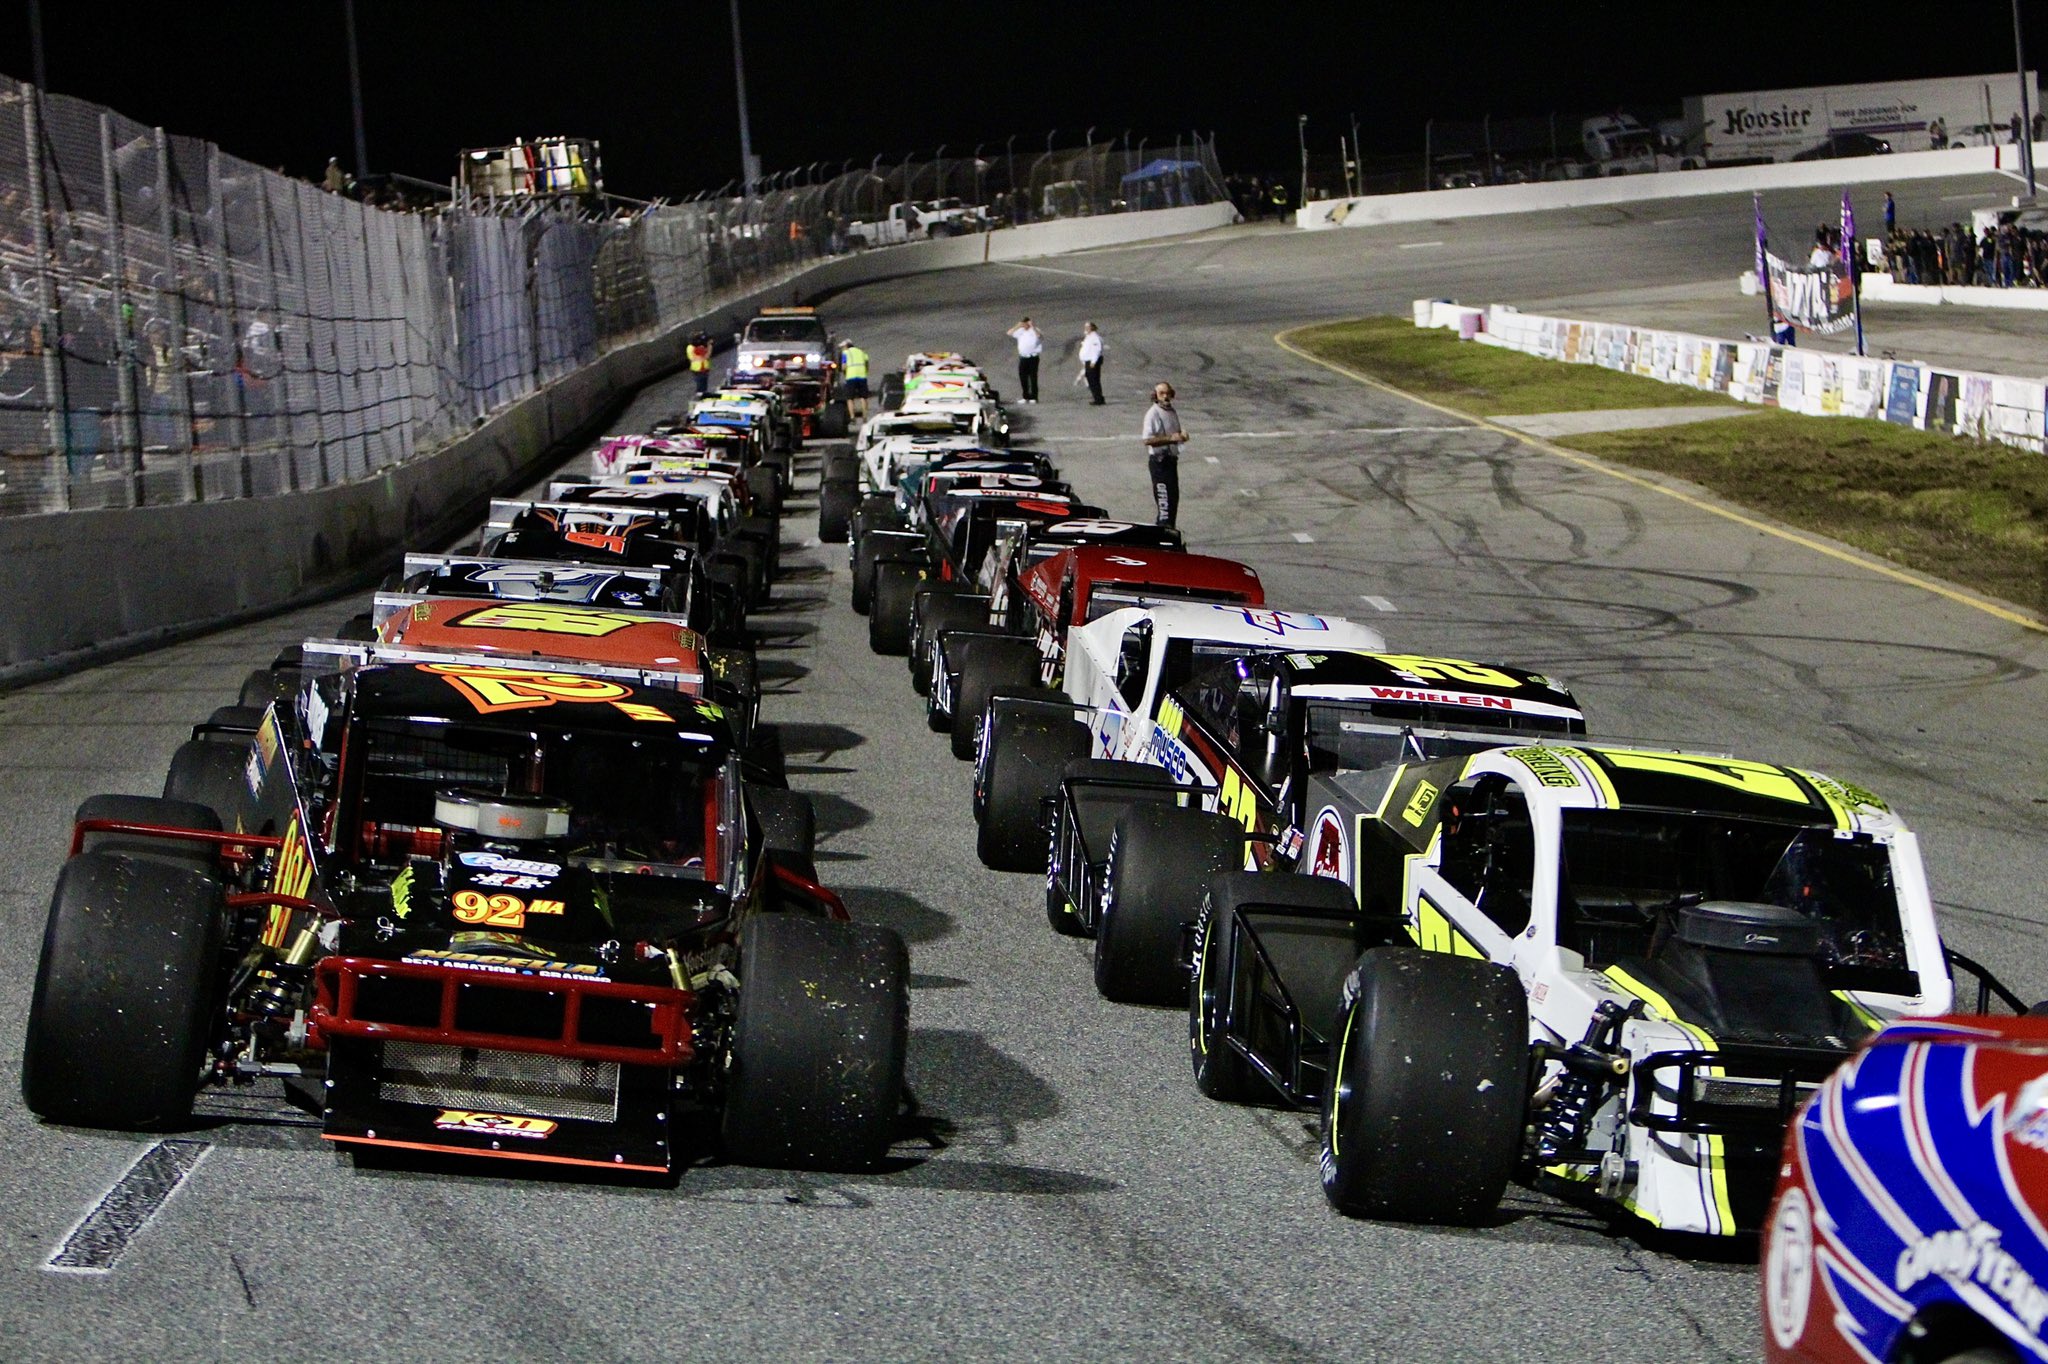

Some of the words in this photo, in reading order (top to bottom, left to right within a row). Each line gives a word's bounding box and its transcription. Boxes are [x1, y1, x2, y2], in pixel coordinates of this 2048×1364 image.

[1723, 104, 1811, 135] Hoosier
[981, 489, 1040, 499] WHELEN
[1369, 686, 1513, 709] WHELEN
[1150, 726, 1187, 782] MUSCO
[452, 890, 526, 928] 92
[526, 899, 566, 915] MA
